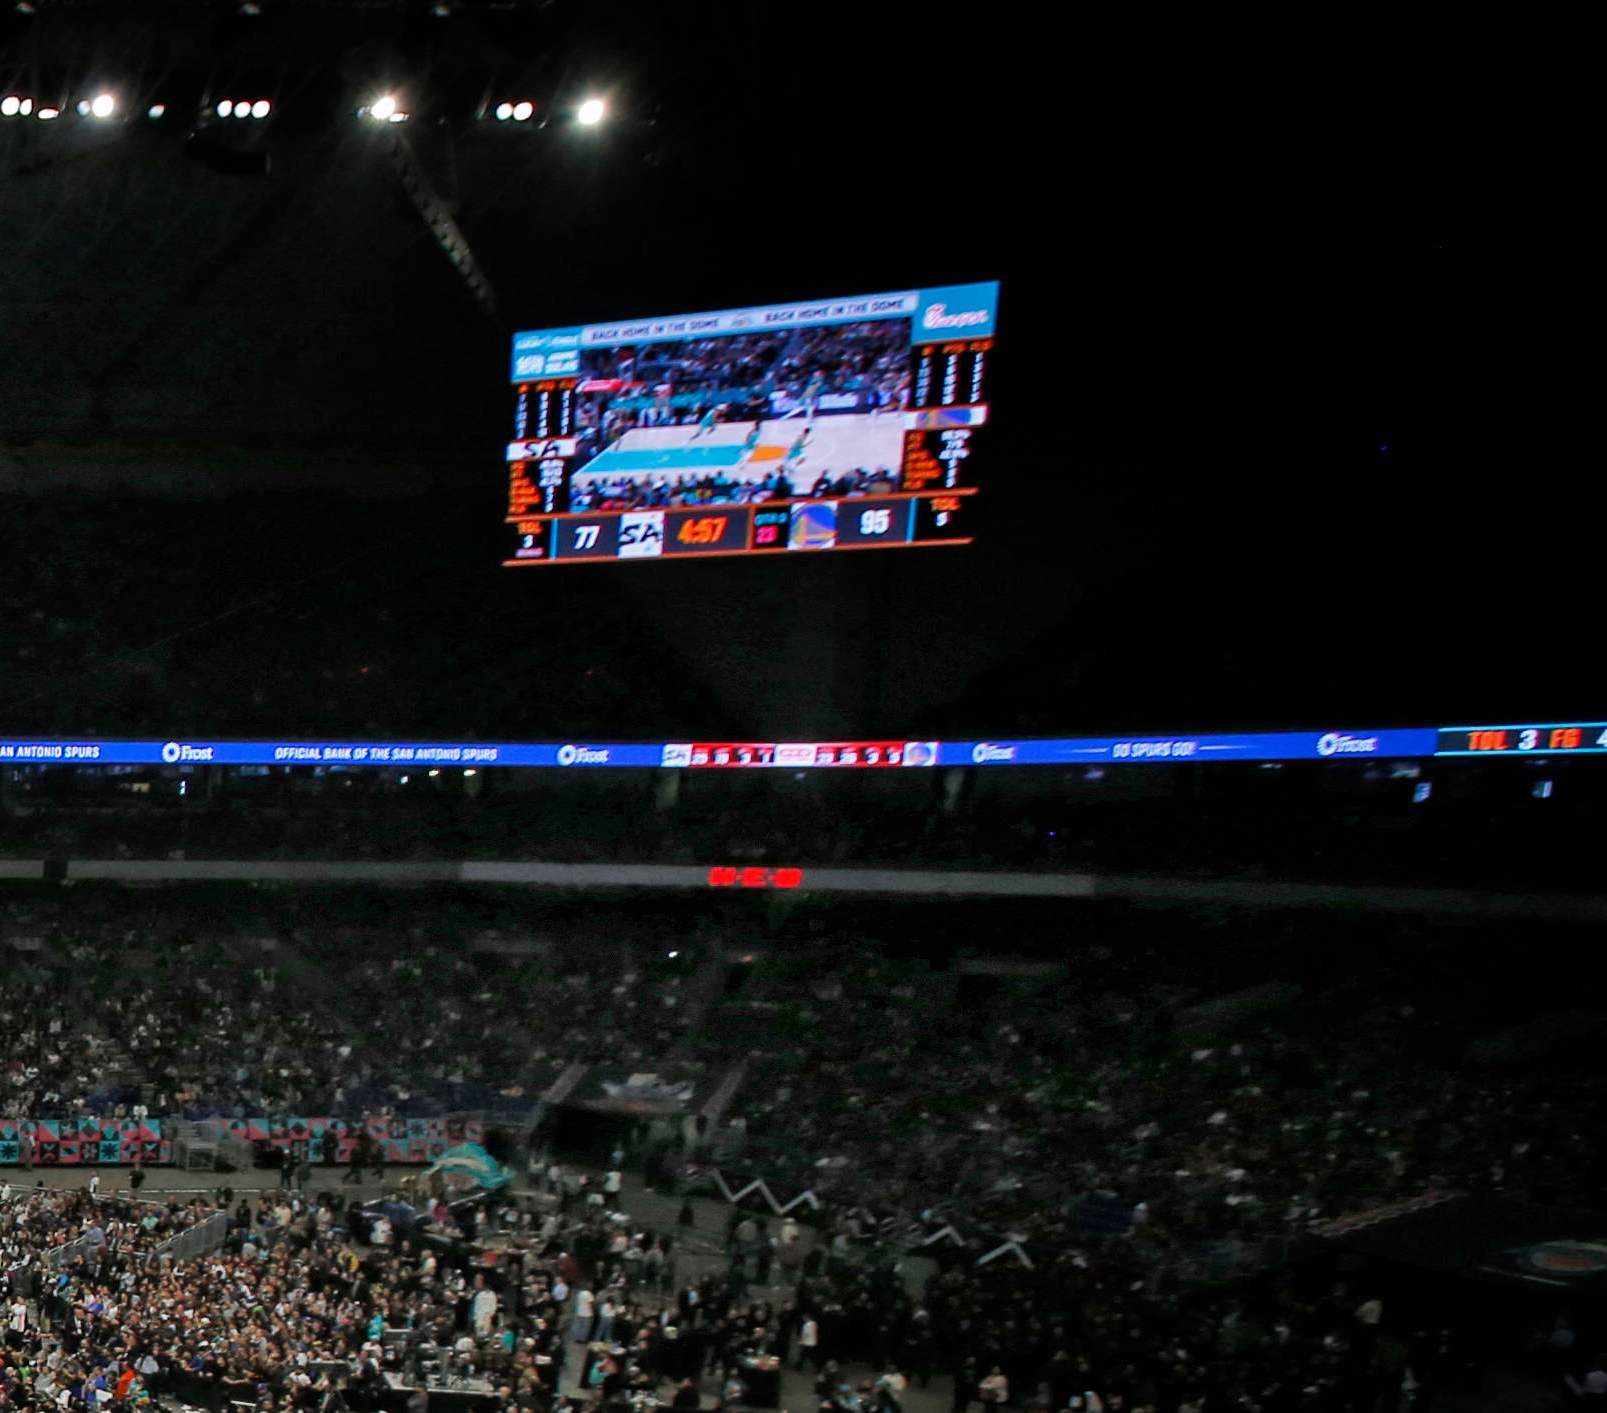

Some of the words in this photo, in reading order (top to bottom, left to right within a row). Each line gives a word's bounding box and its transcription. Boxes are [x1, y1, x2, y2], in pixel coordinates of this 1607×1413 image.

[860, 509, 891, 534] 95
[573, 525, 600, 549] 77
[677, 516, 729, 543] 4:57
[1469, 730, 1508, 750] TOL
[1518, 729, 1537, 750] 3
[1550, 728, 1581, 748] FG
[17, 745, 62, 758] ANTONIO
[65, 745, 100, 758] SPURS
[181, 745, 213, 760] Frost
[275, 747, 321, 760] OFFICIAL
[324, 747, 351, 760] BANK
[353, 747, 368, 760] OF
[370, 748, 389, 760] THE
[391, 748, 414, 760] SAN
[416, 748, 461, 761] ANTONIO
[463, 748, 498, 761] SPURS
